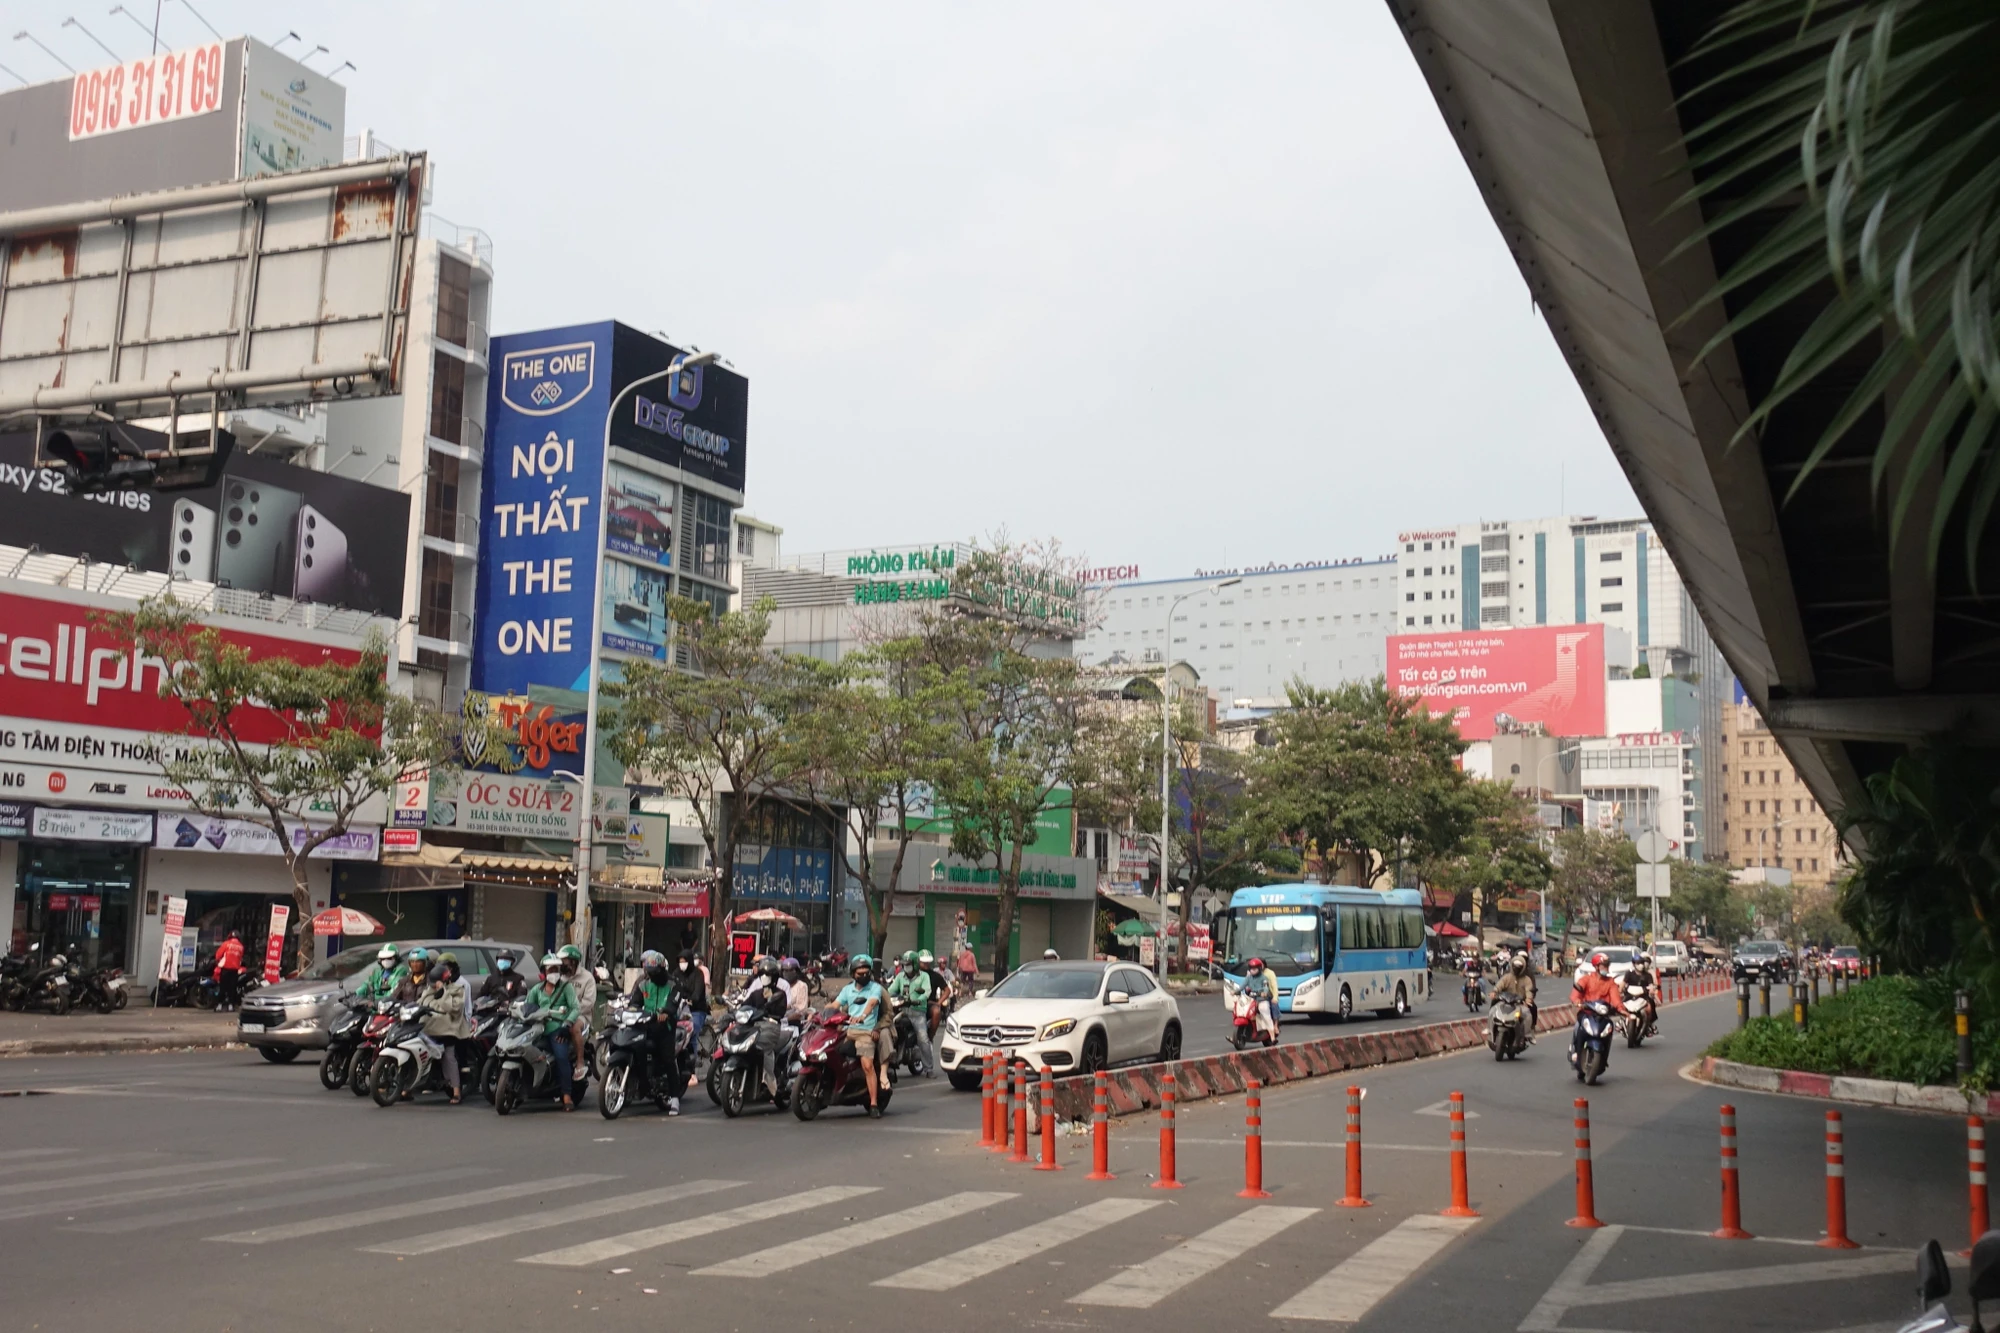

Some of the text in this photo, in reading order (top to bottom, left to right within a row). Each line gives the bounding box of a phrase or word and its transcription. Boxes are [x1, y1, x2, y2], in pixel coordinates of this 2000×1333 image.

[72, 44, 221, 137] 0913 31 31 69
[511, 353, 587, 381] THE ONE
[634, 394, 730, 456] DSG GROUP
[512, 431, 575, 484] NỘI
[494, 485, 589, 538] THẤT
[1412, 530, 1456, 541] Welcome
[847, 544, 955, 575] PHÒNG KHÁM
[503, 557, 574, 596] THE
[1076, 564, 1139, 583] HUTECH
[855, 578, 900, 605] HÀNG
[905, 578, 949, 600] XANH
[498, 618, 574, 656] ONE
[1399, 664, 1487, 682] Tất cả có trên
[22, 729, 60, 752] TÂM
[65, 735, 105, 759] ĐIỆN
[110, 741, 161, 765] THOẠI
[499, 701, 584, 769] Tiger
[88, 782, 128, 795] ASUS
[147, 785, 192, 801] Lenovo
[405, 787, 421, 807] 2
[466, 774, 574, 812] ỐC SỮA 2
[39, 820, 48, 833] 8
[51, 822, 76, 835] Triệu
[101, 823, 110, 837] 2
[113, 826, 137, 841] Triệu
[470, 807, 489, 820] HẢI
[493, 808, 513, 822] SẢN
[542, 812, 567, 827] SỐNG
[350, 834, 369, 849] VIP
[800, 876, 825, 895] PHÁT
[1260, 893, 1285, 905] VIP
